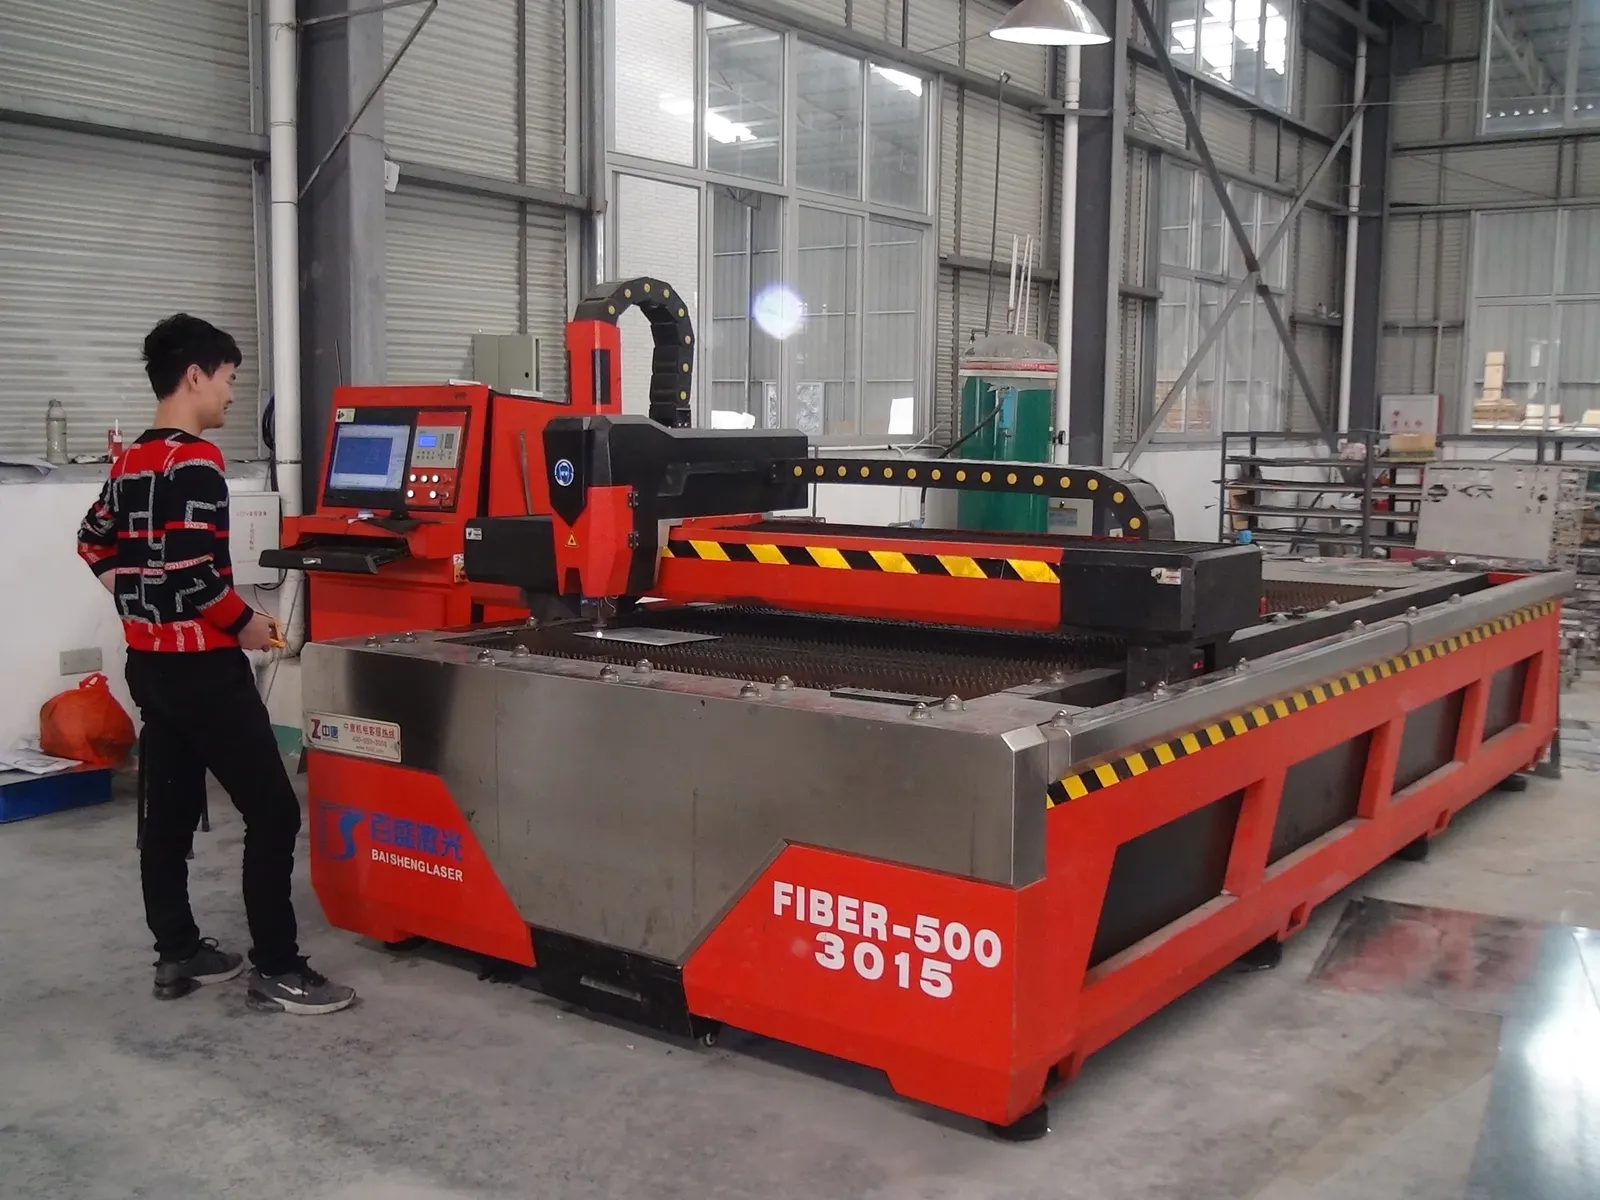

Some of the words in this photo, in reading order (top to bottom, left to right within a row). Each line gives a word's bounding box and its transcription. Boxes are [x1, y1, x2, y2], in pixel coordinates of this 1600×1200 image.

[371, 848, 464, 883] BAISHENGLASER
[773, 880, 1002, 968] FIBER-500
[814, 931, 953, 999] 3015
